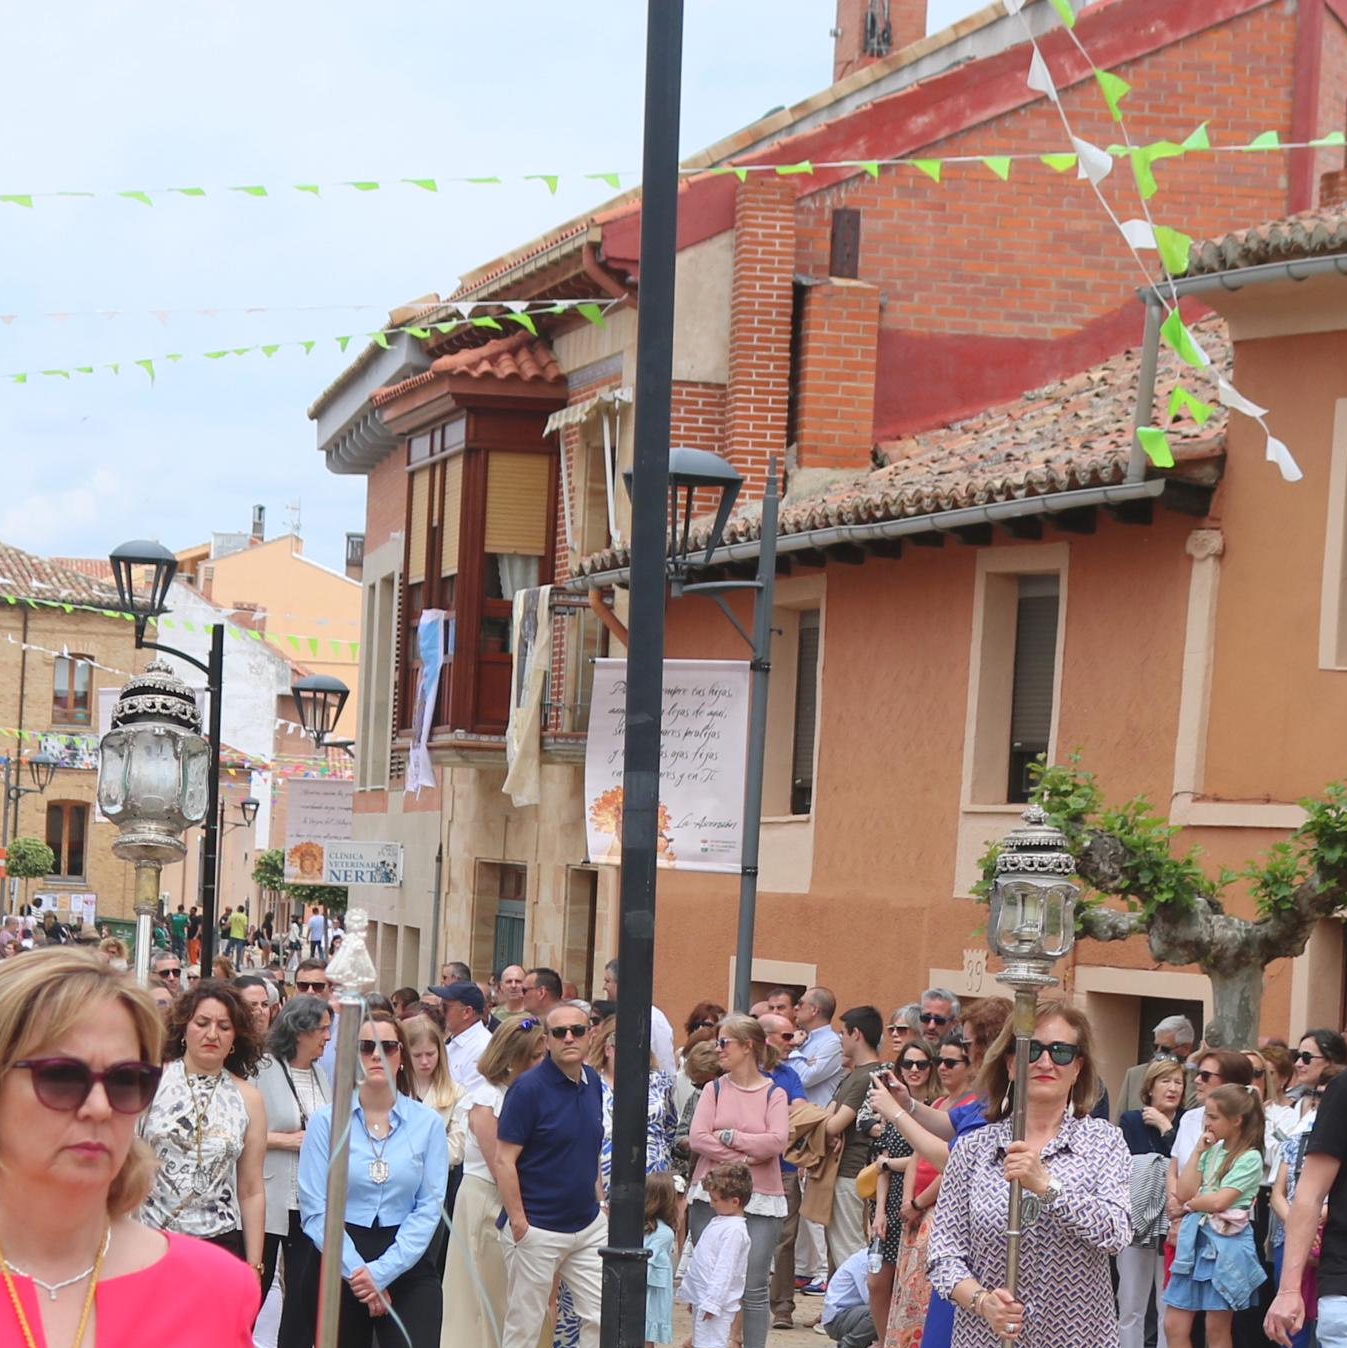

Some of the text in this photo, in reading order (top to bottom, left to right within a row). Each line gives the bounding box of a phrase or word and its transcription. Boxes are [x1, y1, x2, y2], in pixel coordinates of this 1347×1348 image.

[667, 702, 689, 726] lejos
[692, 702, 702, 718] de
[674, 812, 693, 829] La
[966, 960, 982, 992] 39
